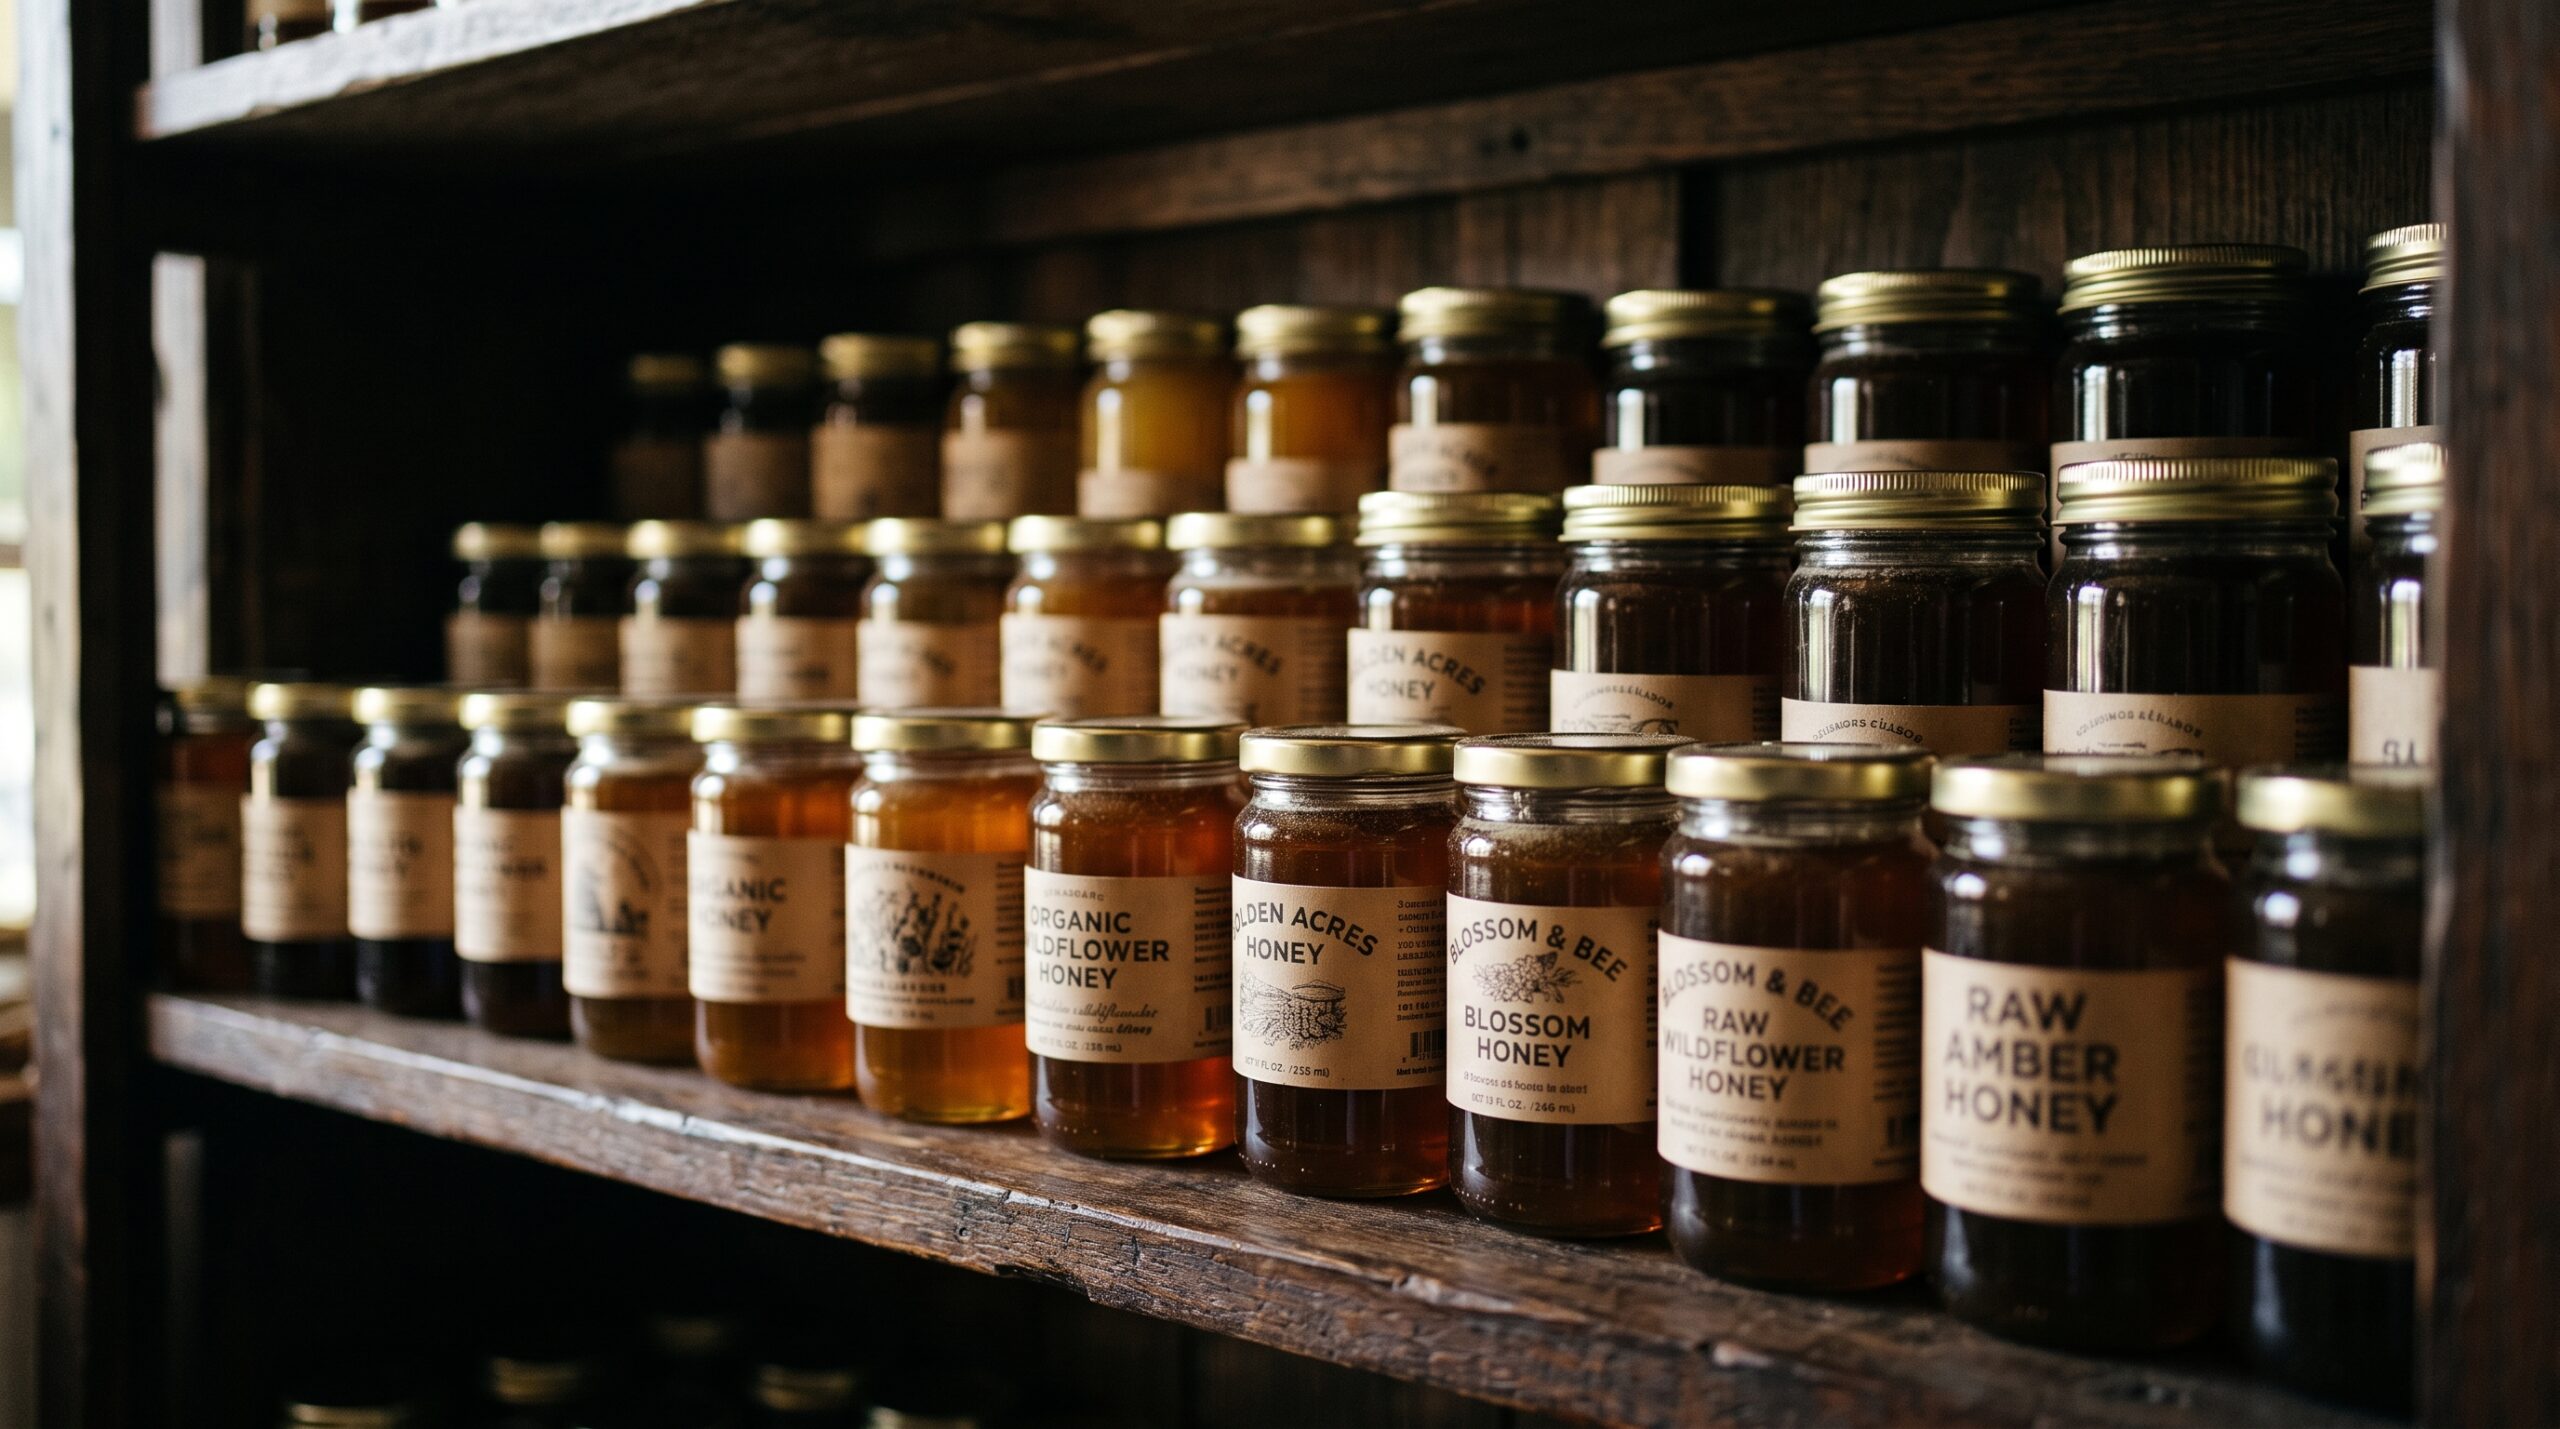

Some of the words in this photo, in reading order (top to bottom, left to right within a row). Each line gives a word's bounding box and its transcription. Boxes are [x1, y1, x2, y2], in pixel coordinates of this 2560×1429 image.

[1412, 648, 1487, 696] ACRES
[1030, 906, 1132, 934] ORGANIC
[1290, 906, 1379, 957] ACRES
[1246, 935, 1325, 966] HONEY
[1449, 917, 1538, 965] BLOSSOM
[1546, 924, 1566, 951] &
[1574, 935, 1628, 983] BEE
[1040, 962, 1118, 989] HONEY
[1662, 960, 1755, 1008] BLOSSOM
[1765, 968, 1787, 996] &
[1794, 978, 1854, 1033] BEE
[1465, 1005, 1591, 1040] BLOSSOM
[1703, 1007, 1770, 1036] RAW
[1967, 985, 2087, 1033] RAW
[1477, 1036, 1572, 1068] HONEY
[1663, 1029, 1845, 1073] WILDFLOWER
[1944, 1030, 2118, 1085] AMBER
[1689, 1066, 1789, 1100] HONEY
[1944, 1078, 2118, 1135] HONEY
